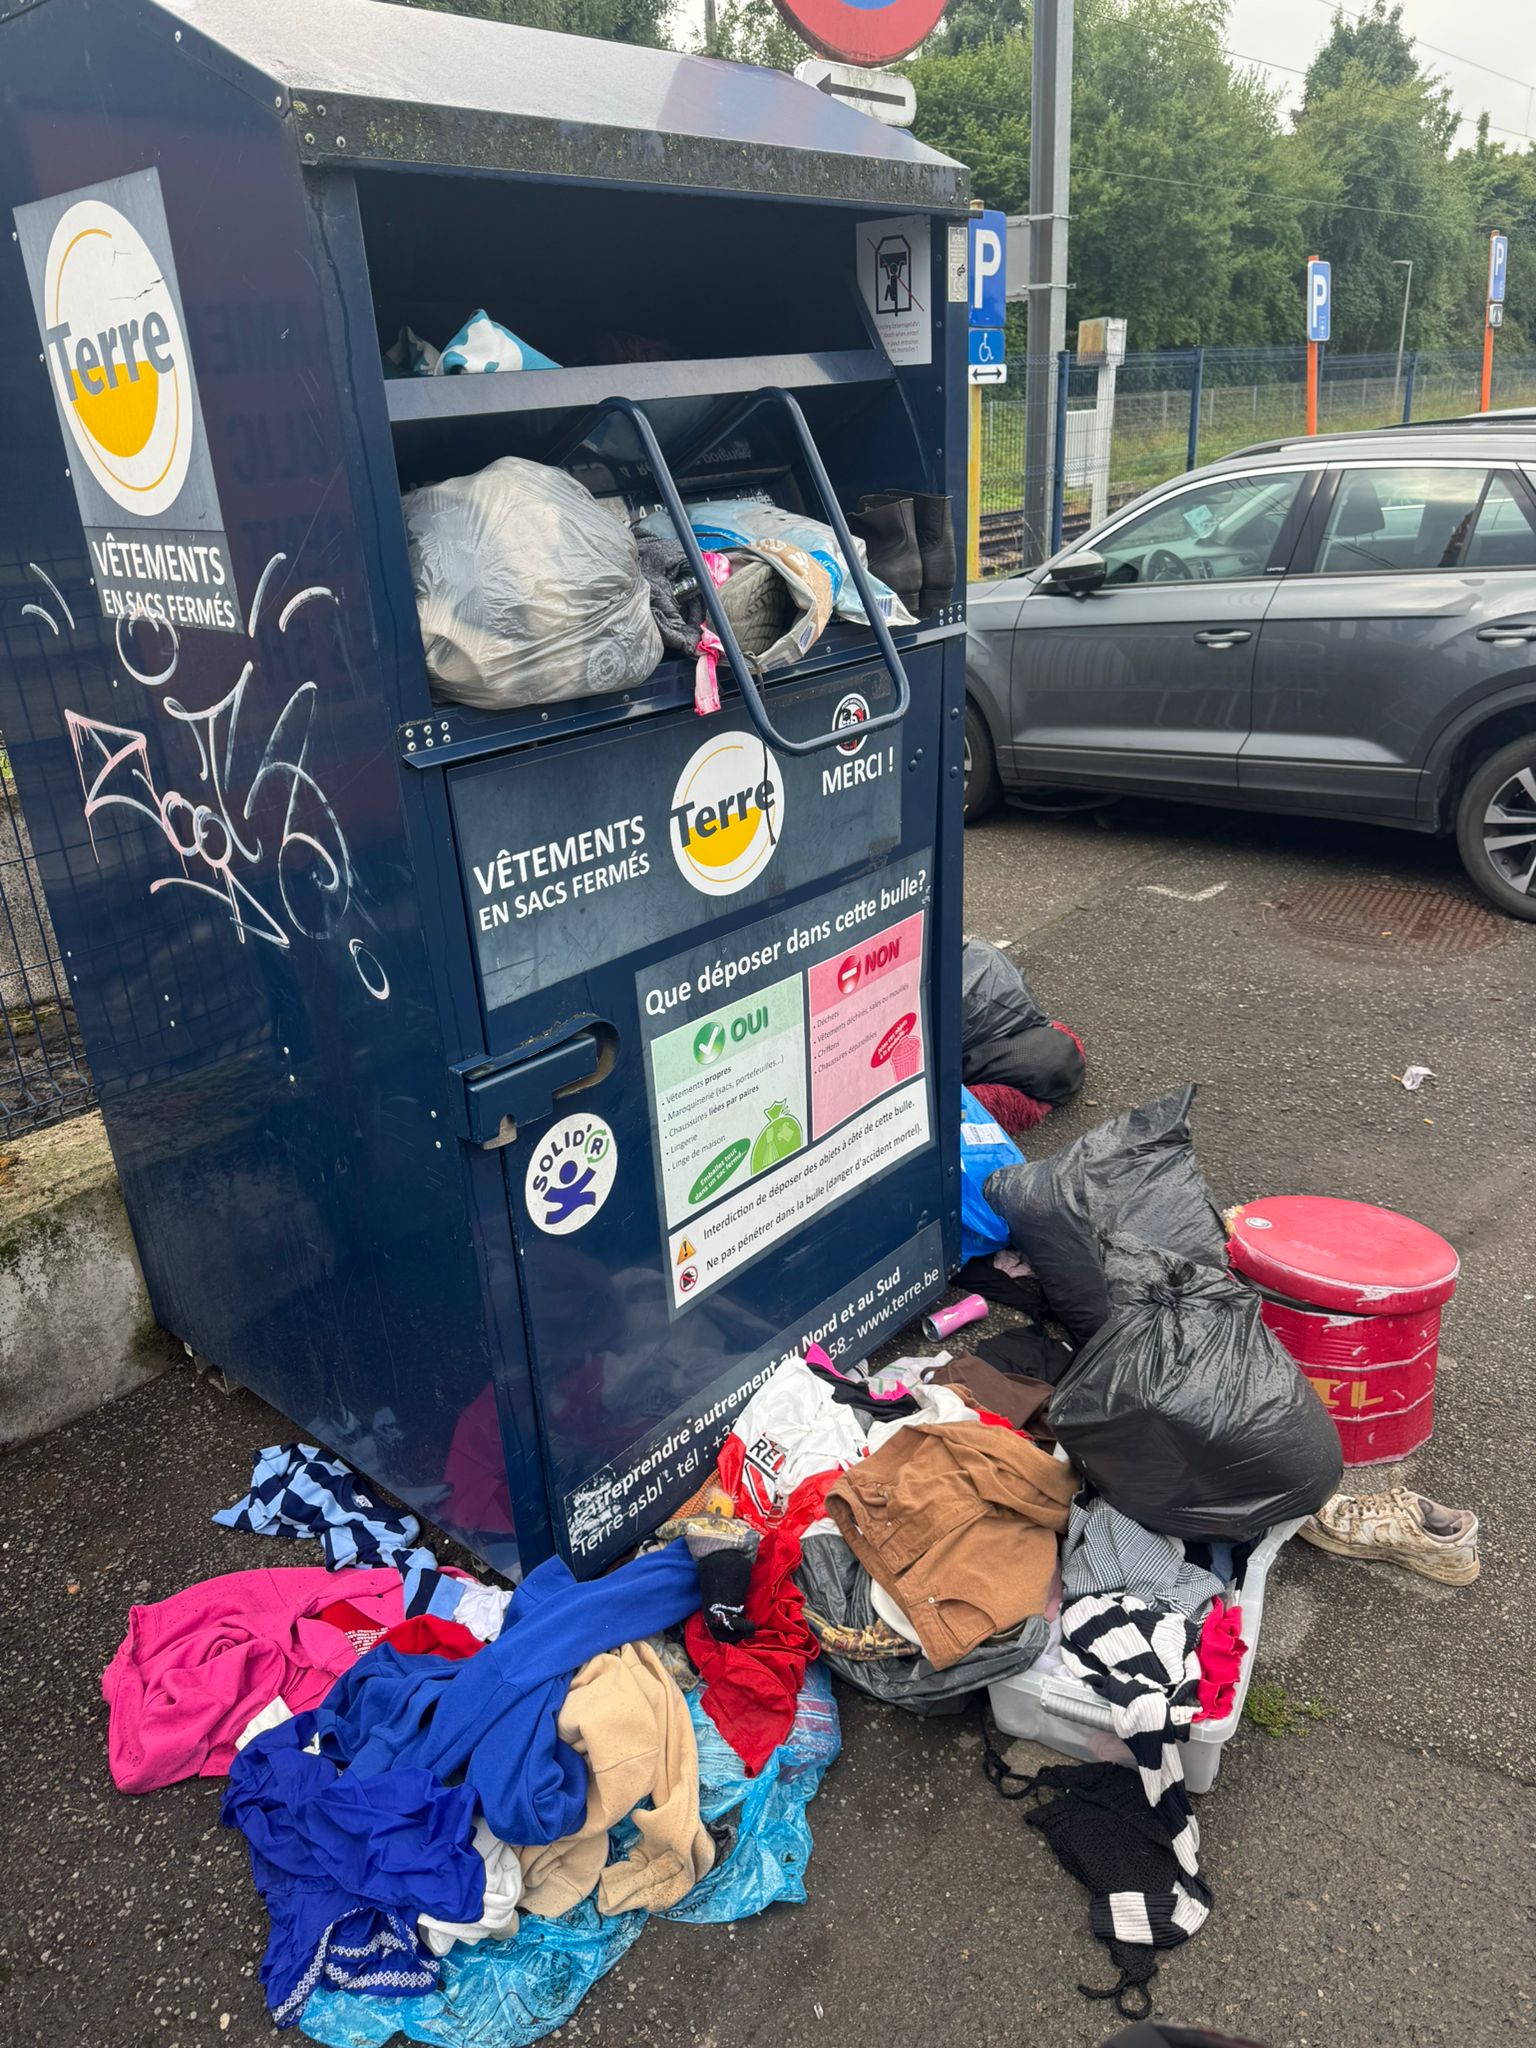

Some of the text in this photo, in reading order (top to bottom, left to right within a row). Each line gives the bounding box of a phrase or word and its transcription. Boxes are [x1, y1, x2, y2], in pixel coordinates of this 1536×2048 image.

[974, 228, 1002, 309] P
[1495, 243, 1504, 276] P
[1313, 274, 1327, 328] P
[47, 311, 175, 402] Terre
[92, 532, 225, 586] VÊTEMENTS
[103, 589, 236, 628] EN SACS FERMÉS
[822, 752, 883, 796] MERCI
[670, 780, 775, 848] Terre
[473, 815, 646, 895] VÊTEMENTS
[479, 850, 650, 931] EN SACS FERMÉS
[645, 869, 927, 1016] Que déposer dans cette bulle?
[864, 938, 900, 975] NON
[730, 1006, 768, 1042] OUI
[665, 1066, 732, 1104] Vêtements propres
[667, 1091, 715, 1120] Maroquinerie
[669, 1085, 760, 1138] Chaussures liées par paires
[670, 1133, 698, 1155] Lingerie
[671, 1134, 726, 1171] Linge de maison
[703, 1201, 754, 1240] Interdiction
[756, 1193, 767, 1207] de
[769, 1169, 802, 1199] déposer
[804, 1162, 818, 1177] des
[818, 1143, 841, 1167] objets
[847, 1129, 863, 1146] côté
[864, 1122, 874, 1134] de
[875, 1112, 894, 1128] cette
[894, 1098, 915, 1116] bulle.
[706, 1122, 923, 1271] Ne pas pénétrer dans la bulle (danger d'accident mortel).
[694, 1361, 777, 1434] autrement
[801, 1313, 838, 1353] Nord
[840, 1303, 855, 1324] et
[857, 1290, 874, 1311] au
[876, 1266, 901, 1297] Sud
[577, 1514, 624, 1557] Terre
[629, 1476, 663, 1518] asbl
[677, 1448, 700, 1478] tél
[857, 1268, 939, 1339] www.terre.be
